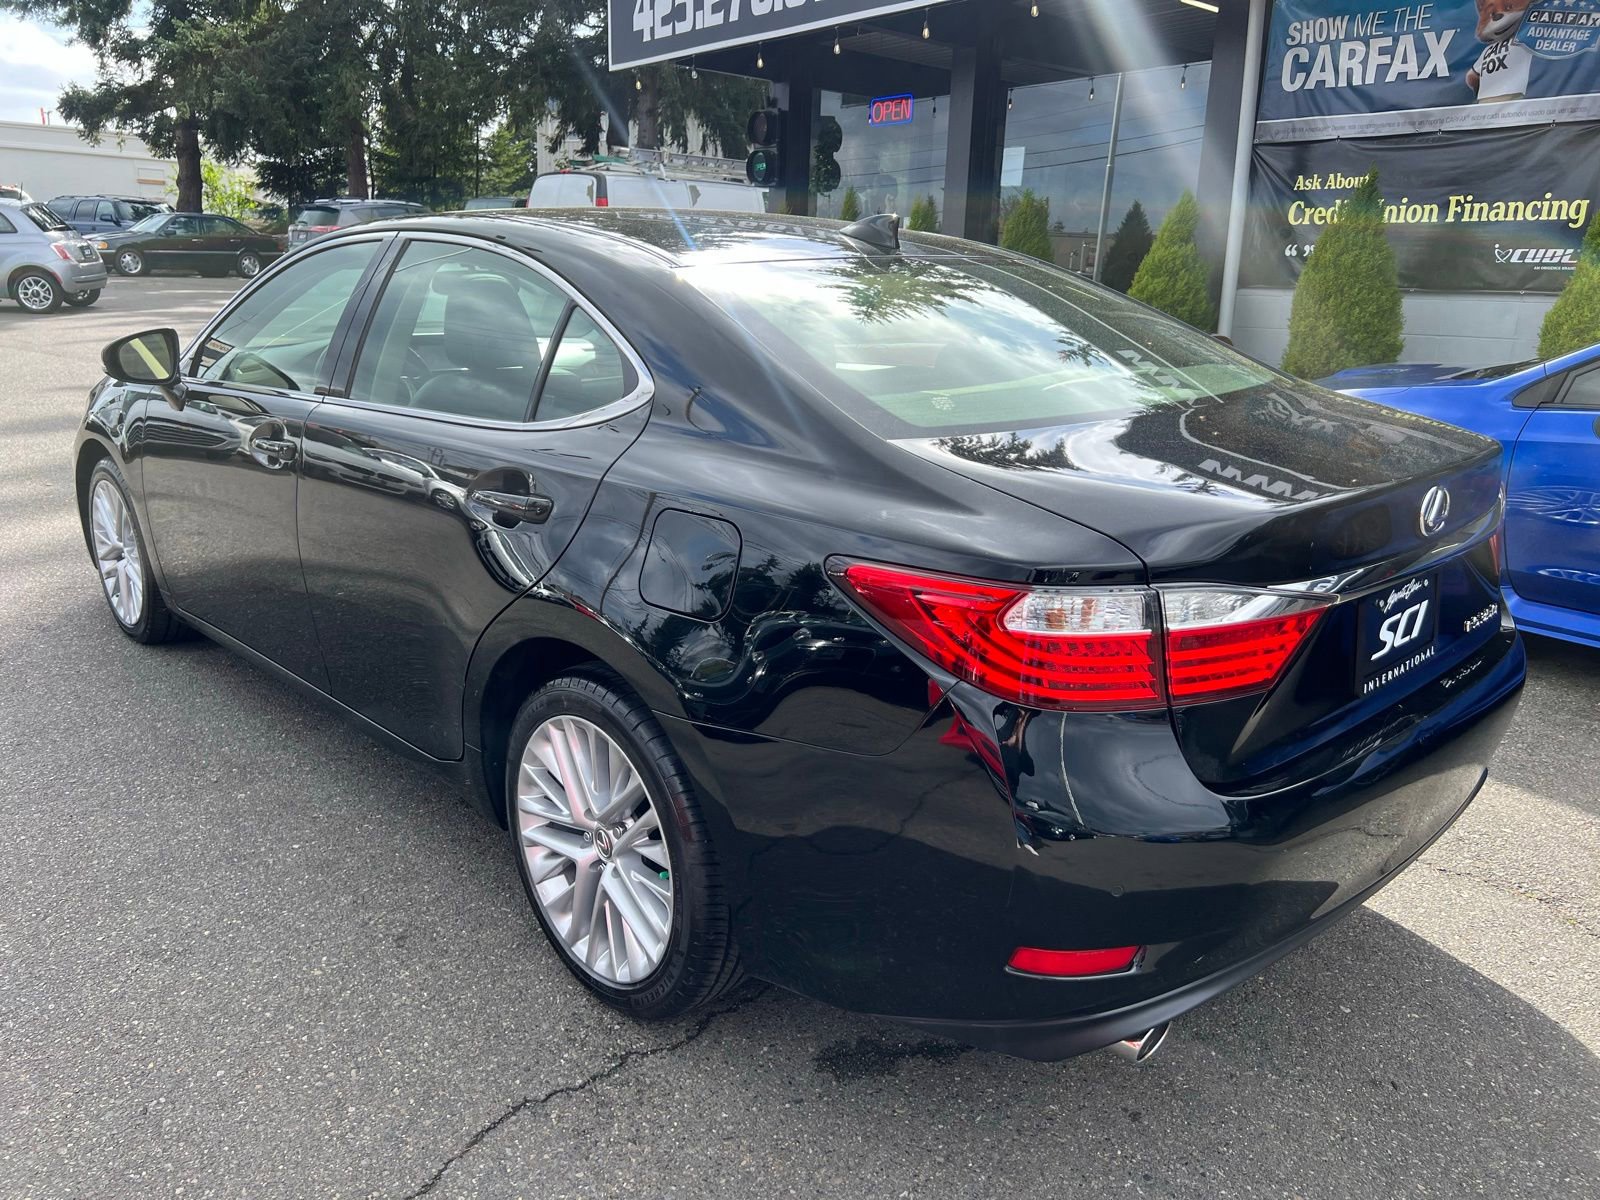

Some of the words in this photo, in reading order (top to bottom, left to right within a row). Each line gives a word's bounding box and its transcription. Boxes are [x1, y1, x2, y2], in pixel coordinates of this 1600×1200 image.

[1286, 15, 1349, 46] SHOW
[1354, 10, 1388, 37] ME
[1394, 3, 1433, 32] THE
[1530, 11, 1600, 27] CARFAX
[1527, 26, 1592, 40] ADVANTAGE
[1483, 41, 1510, 60] CAR
[1535, 39, 1577, 52] DEALER
[1281, 29, 1456, 92] CARFAX
[1480, 54, 1508, 77] FOX
[872, 98, 911, 123] OPEN
[1293, 174, 1322, 191] Ask
[1287, 199, 1349, 226] Cred
[1378, 198, 1438, 224] nion
[1445, 192, 1590, 229] Financing
[1363, 645, 1435, 694] INTERNATIONAL
